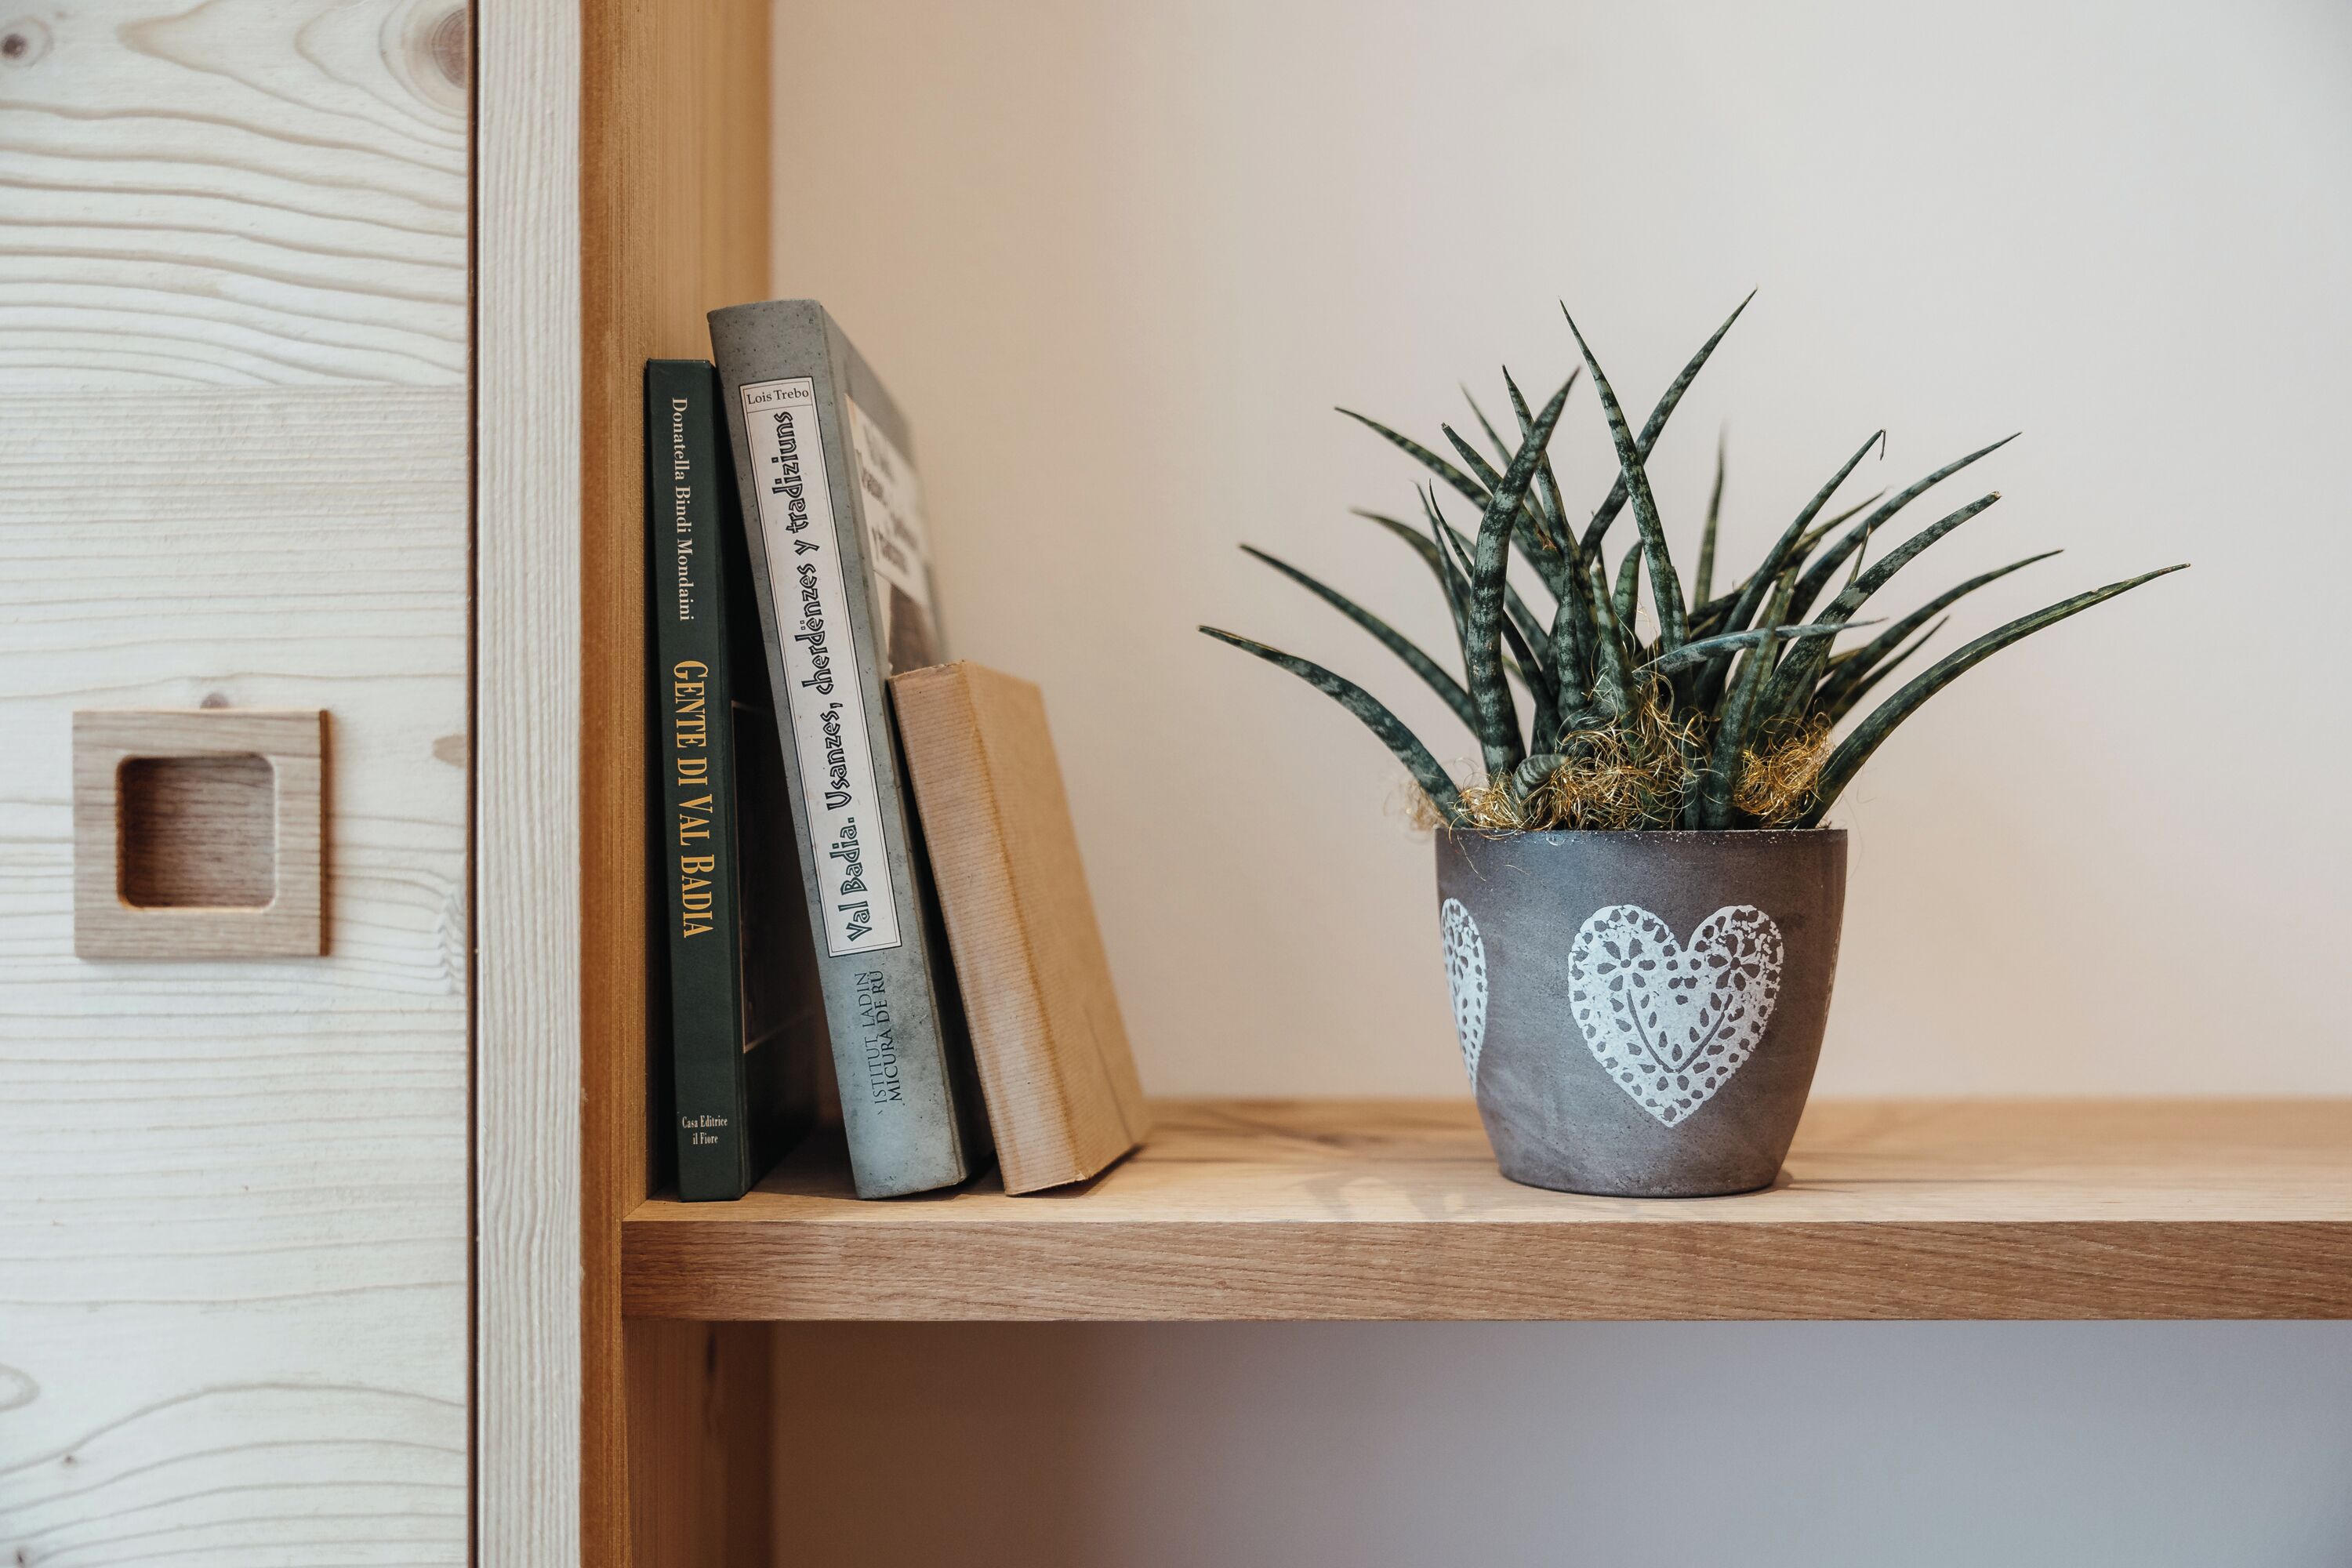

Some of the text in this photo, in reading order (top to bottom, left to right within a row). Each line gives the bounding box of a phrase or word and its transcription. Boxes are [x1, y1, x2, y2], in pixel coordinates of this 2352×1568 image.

[746, 387, 809, 405] Lois Trebo
[672, 397, 695, 622] Donatella Bindi Mondaini
[771, 412, 873, 942] Val Badia. Usanzes, cherdënzes y tradiziuns
[673, 660, 715, 938] GENTE DI VAL BADIA
[855, 972, 887, 1104] ISTITUT LADIN
[867, 971, 902, 1102] MICURA DE RÜ
[682, 1115, 728, 1128] Casa Editrice
[692, 1132, 718, 1145] il Fiore
